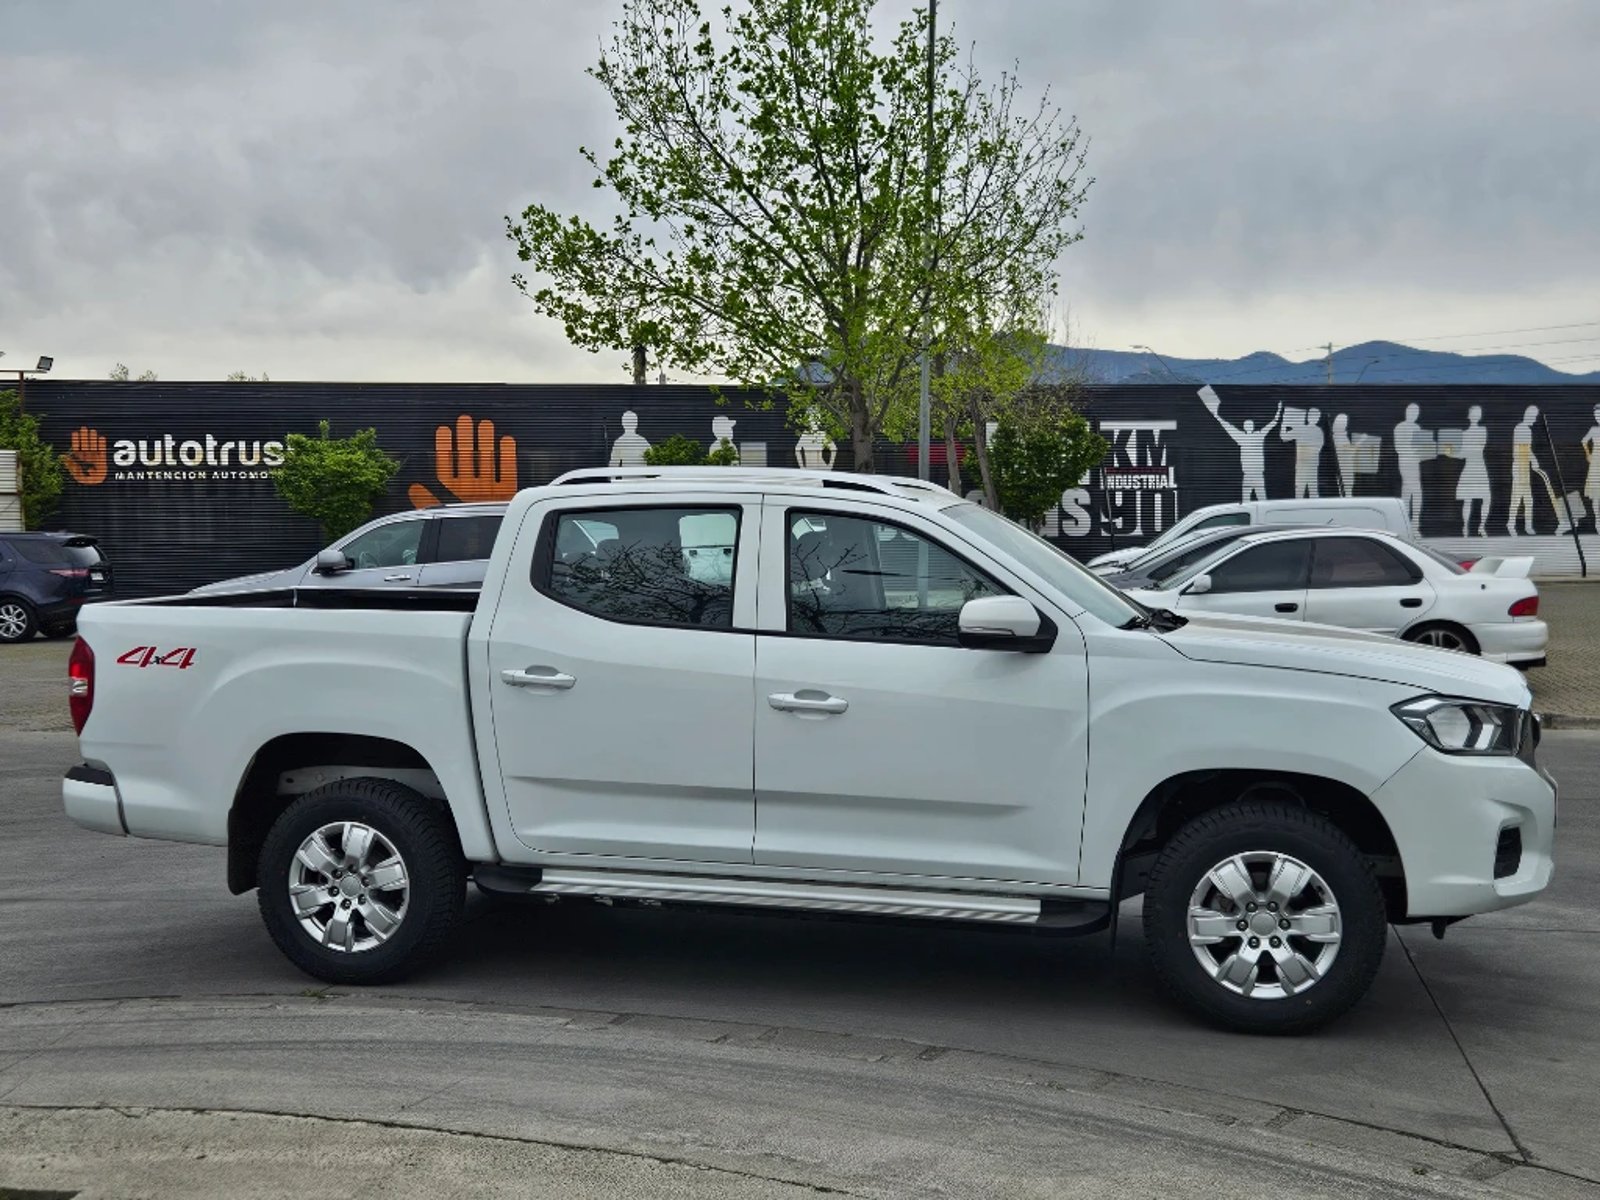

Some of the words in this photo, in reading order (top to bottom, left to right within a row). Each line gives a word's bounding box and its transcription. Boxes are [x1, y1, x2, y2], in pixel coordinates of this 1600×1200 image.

[113, 434, 292, 466] autotrus
[1102, 428, 1175, 467] KM
[115, 471, 206, 480] MANTENCION
[212, 471, 273, 480] AUTOMO
[116, 646, 197, 669] 4x4
